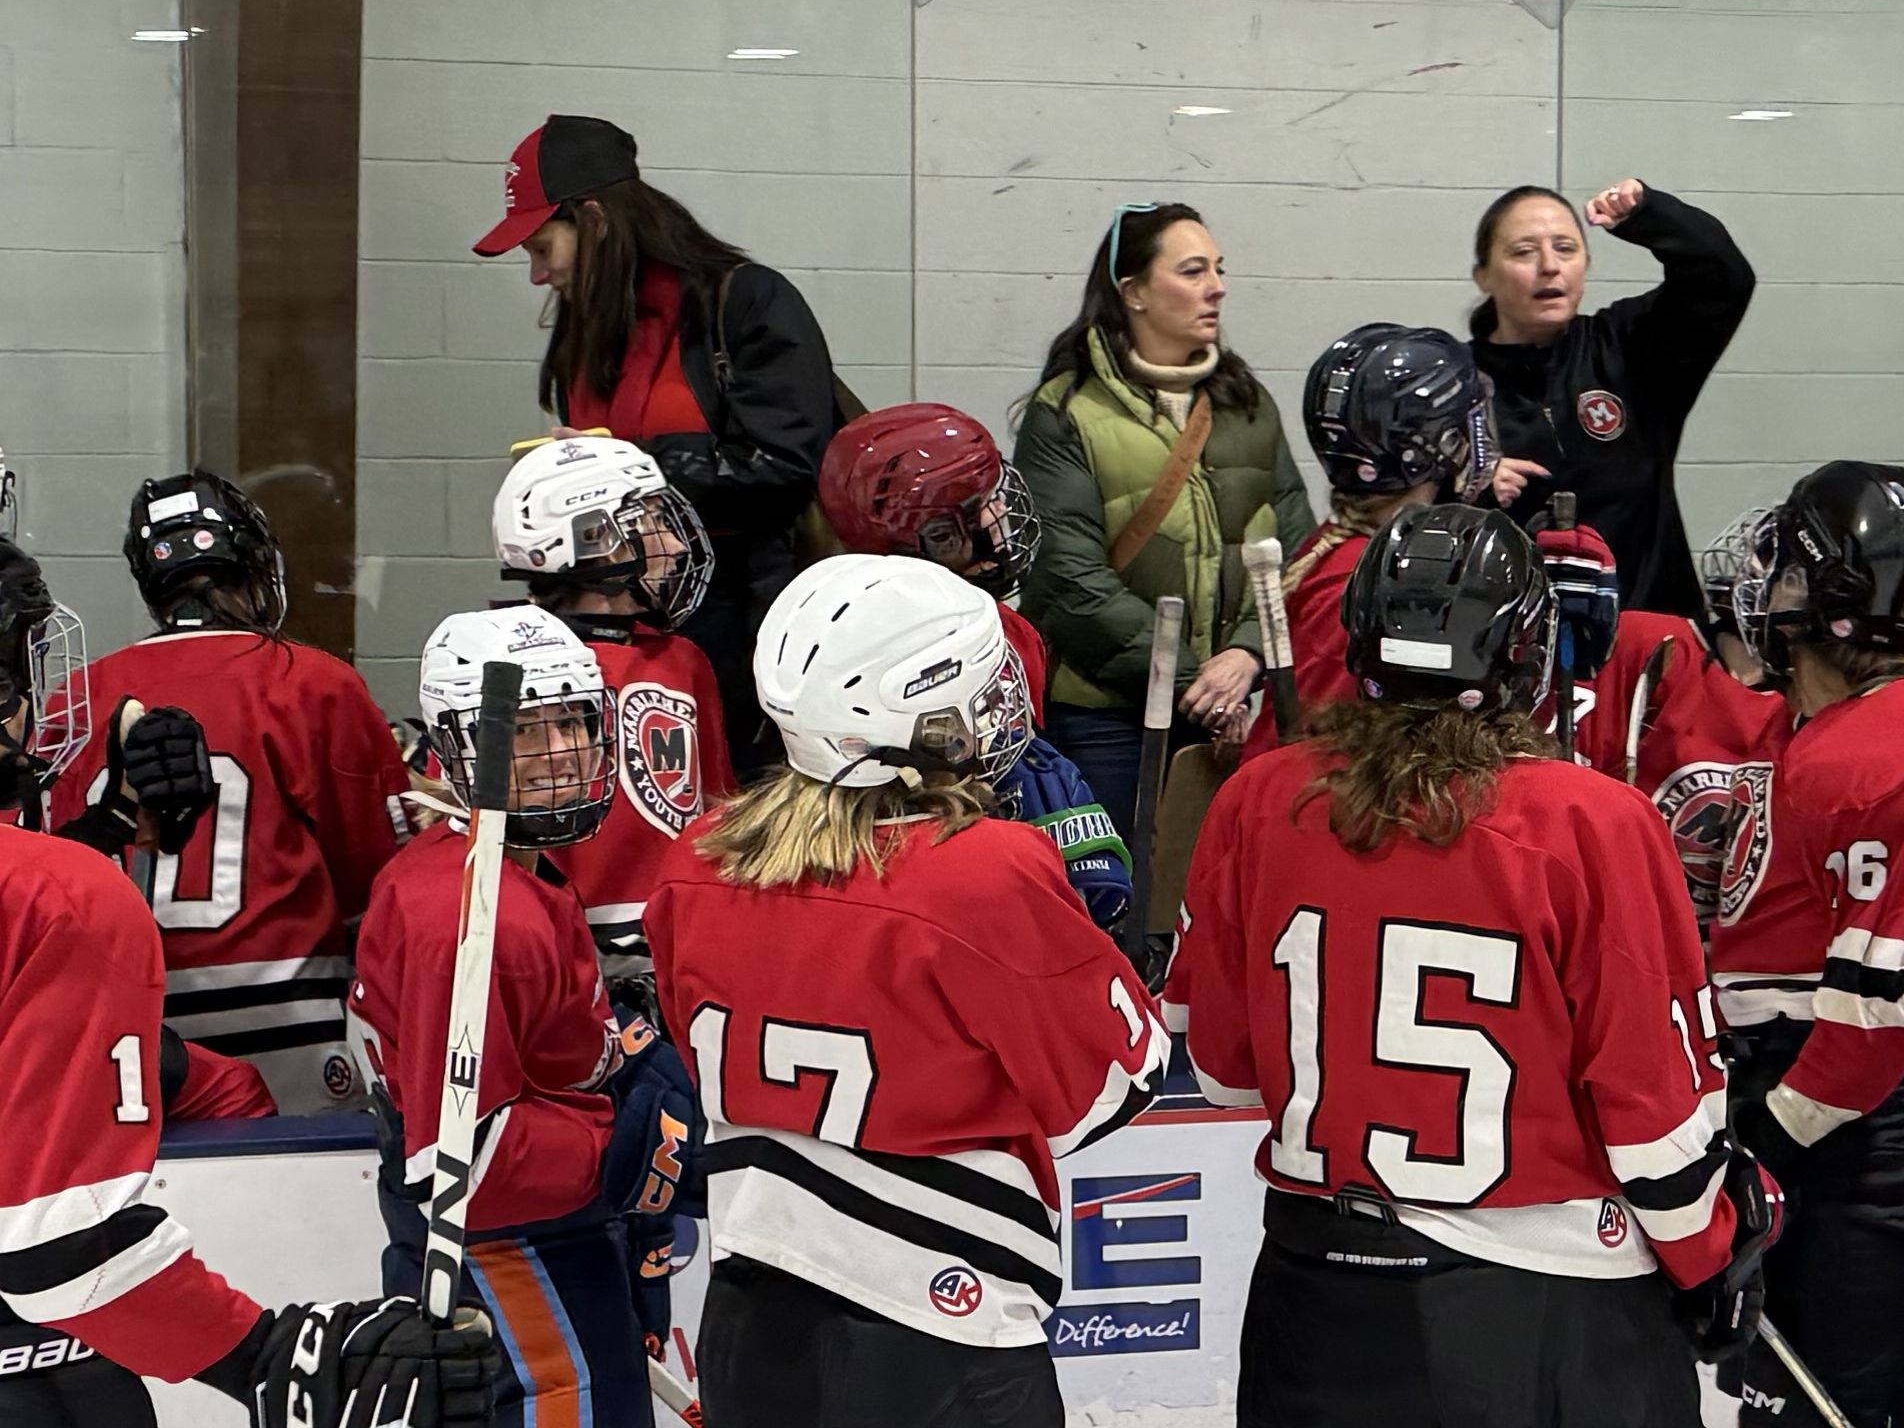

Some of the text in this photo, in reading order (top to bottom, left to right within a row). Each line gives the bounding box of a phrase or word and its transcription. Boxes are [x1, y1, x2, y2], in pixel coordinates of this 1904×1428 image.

[564, 487, 609, 507] CCM
[649, 726, 688, 772] M
[689, 1002, 876, 1151] 17
[1274, 906, 1521, 1205] 15
[1054, 1312, 1191, 1349] Difference!
